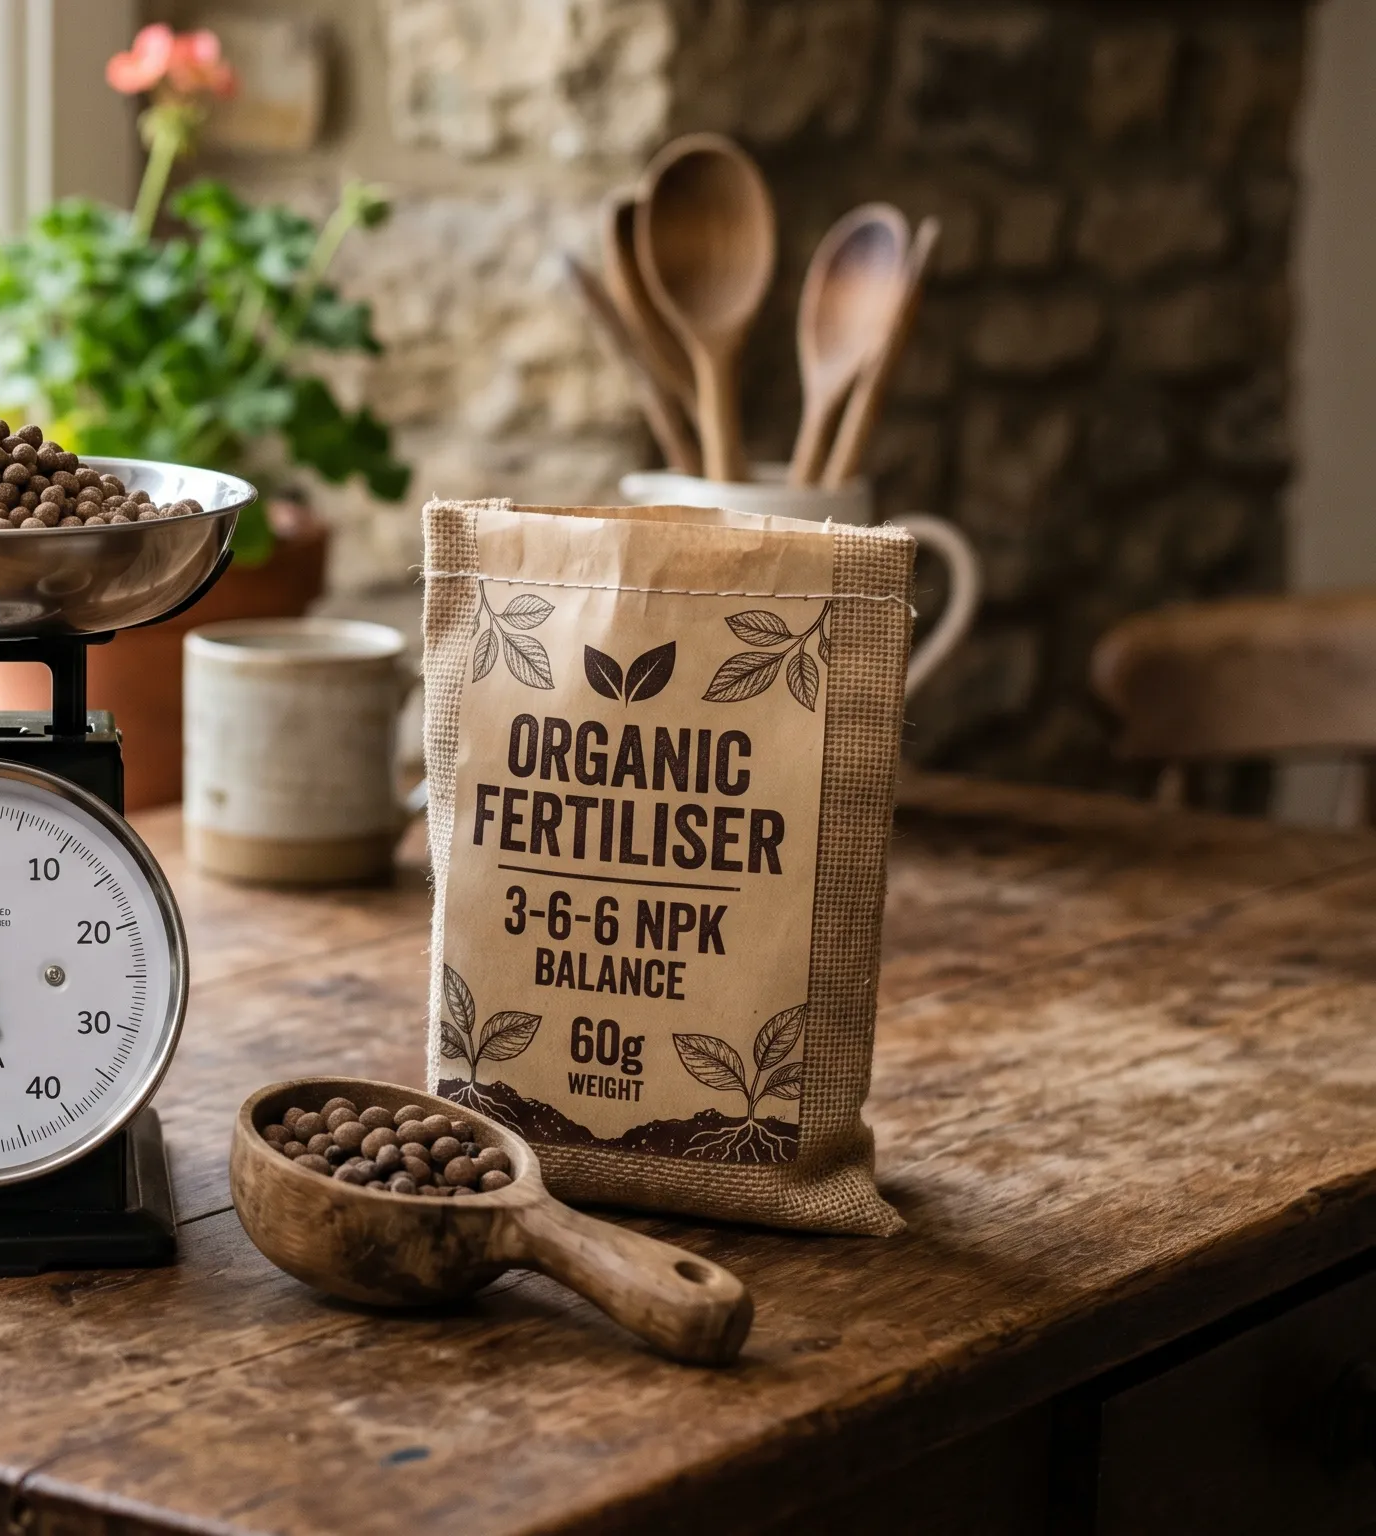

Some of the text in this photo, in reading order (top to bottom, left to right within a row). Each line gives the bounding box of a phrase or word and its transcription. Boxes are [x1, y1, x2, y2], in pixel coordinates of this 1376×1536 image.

[508, 713, 752, 797] ORGANIC
[473, 783, 785, 875] FERTILISER
[28, 857, 60, 881] 10
[76, 920, 111, 944] 20
[504, 885, 728, 955] 3-6-6 NPK
[535, 947, 687, 1001] BALANCE
[77, 1010, 111, 1034] 30
[569, 1016, 645, 1075] 60g
[25, 1075, 61, 1100] 40
[567, 1072, 644, 1102] WEIGHT
